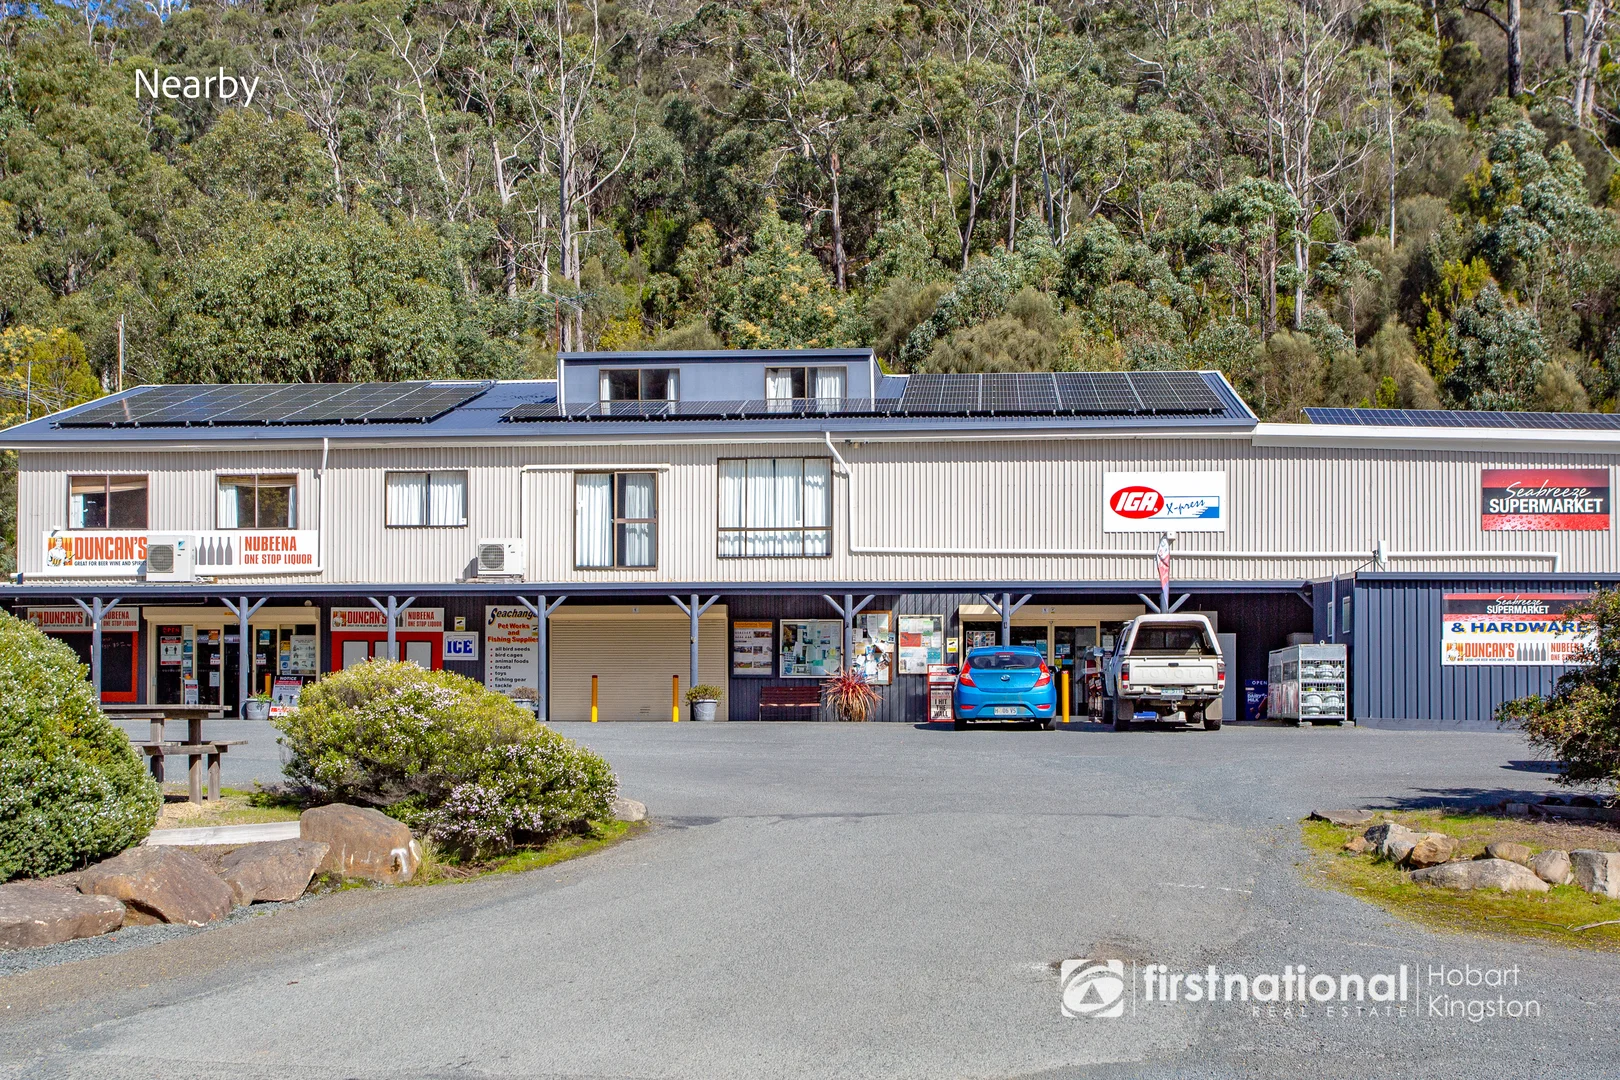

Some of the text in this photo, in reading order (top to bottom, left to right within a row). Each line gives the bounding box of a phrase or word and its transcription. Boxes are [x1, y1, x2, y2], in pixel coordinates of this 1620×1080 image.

[1504, 479, 1591, 501] Seabreeze
[1115, 491, 1206, 515] IGA X-press
[1489, 498, 1604, 513] SUPERMARKET
[74, 536, 147, 560] DUNCAN'S
[244, 536, 297, 552] NUBEENA
[244, 554, 313, 566] ONE STOP LIQUOR
[1495, 595, 1543, 607] Seabreeze
[408, 612, 435, 620] NUBEENA
[1486, 605, 1550, 614] SUPERMARKET
[44, 612, 83, 624] DUNCAN'S
[1451, 622, 1465, 633] &
[447, 640, 473, 654] ICE
[1465, 643, 1515, 658] DUNCAN'S
[1140, 669, 1206, 679] TOYOTA
